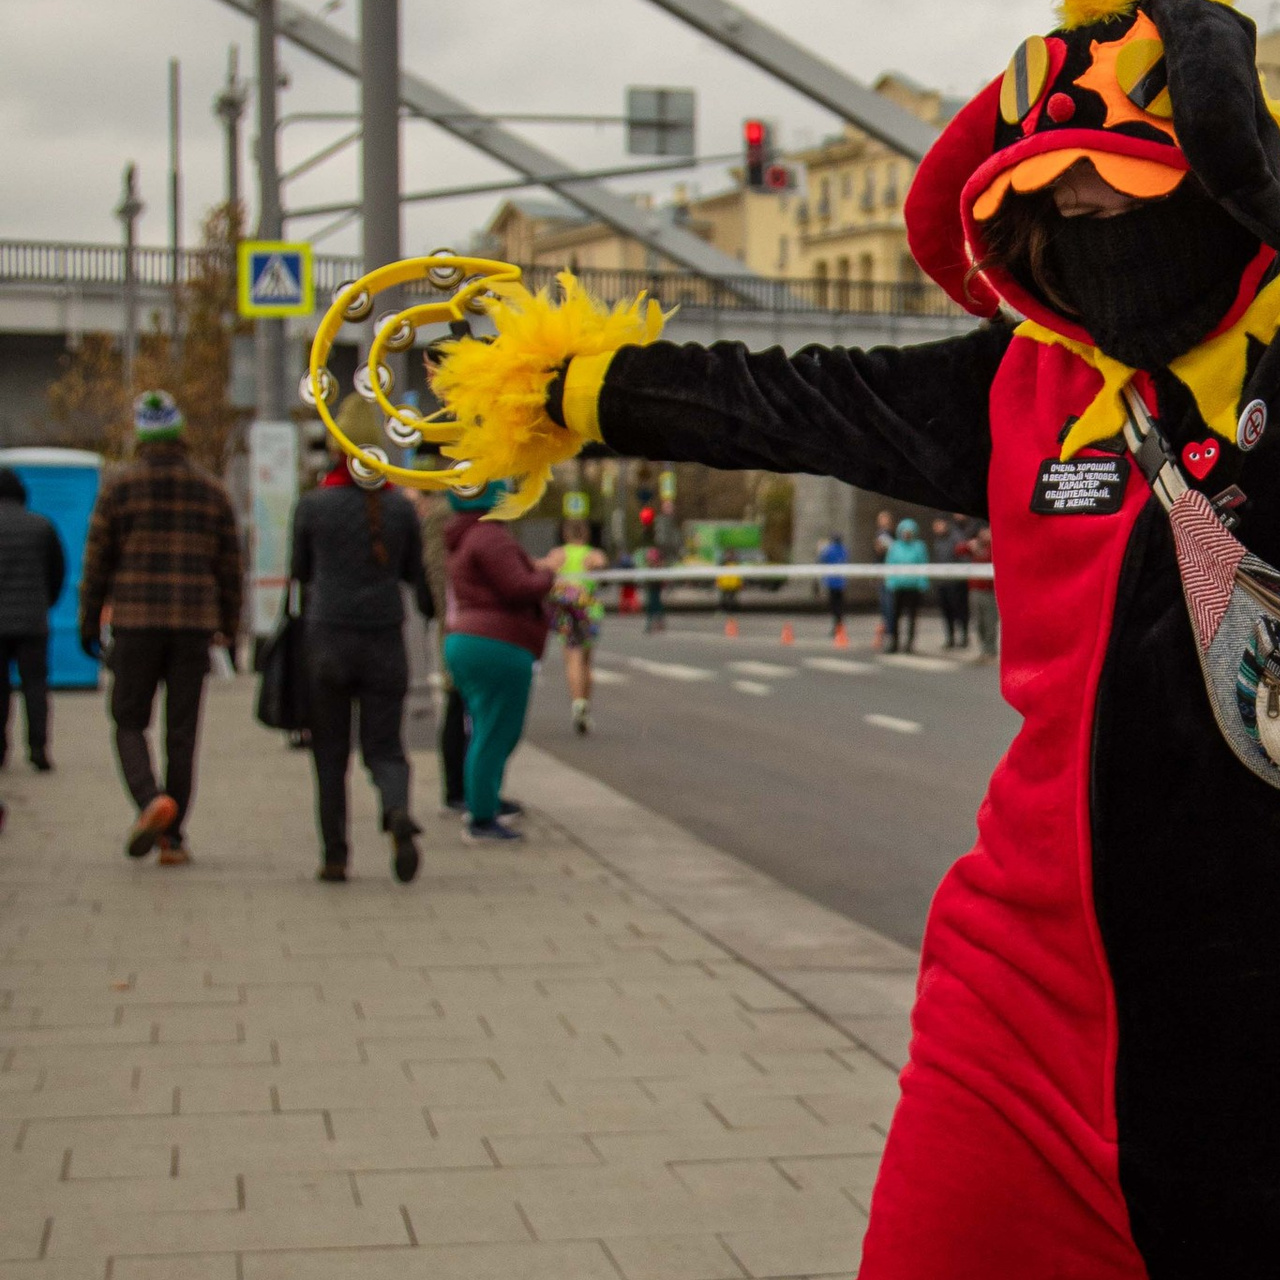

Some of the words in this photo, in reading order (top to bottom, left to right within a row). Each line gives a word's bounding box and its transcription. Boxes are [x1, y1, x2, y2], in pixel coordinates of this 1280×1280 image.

[1051, 463, 1075, 472] ОЧЕНЬ
[1077, 461, 1116, 471] ХОРОШИЙ
[1042, 473, 1048, 481] И
[1049, 472, 1083, 481] ВЕСЁЛЫЙ
[1085, 472, 1120, 481] ЧЕЛОВЕК.
[1058, 480, 1100, 490] ХАРАКТЕР
[1045, 487, 1111, 499] ОБЩИТЕЛЬНЫЙ.
[1053, 499, 1065, 508] НЕ
[1066, 498, 1096, 507] ЖЕНАТ.
